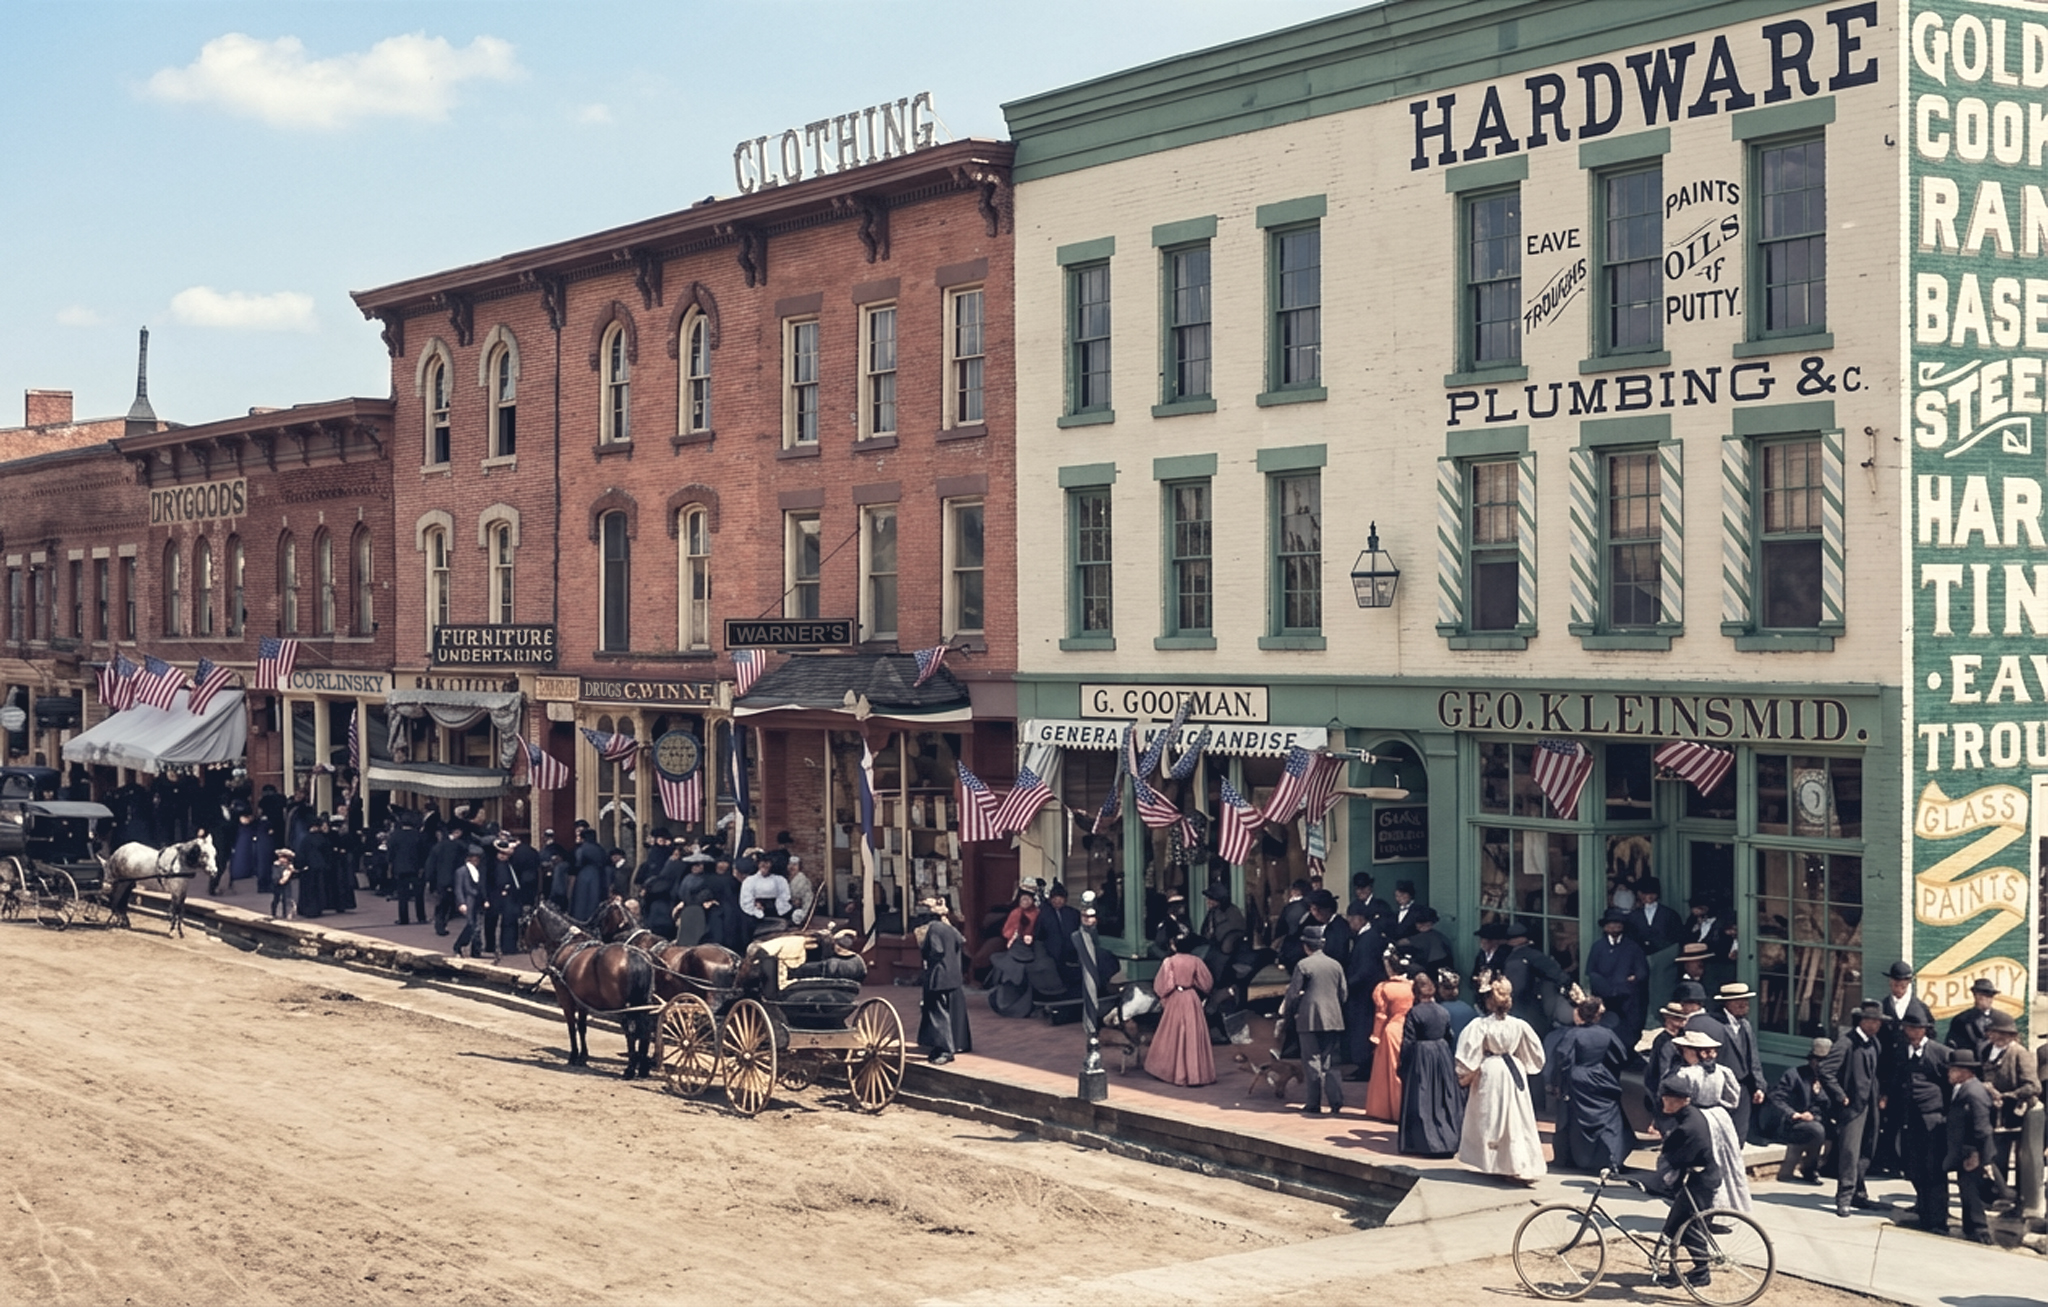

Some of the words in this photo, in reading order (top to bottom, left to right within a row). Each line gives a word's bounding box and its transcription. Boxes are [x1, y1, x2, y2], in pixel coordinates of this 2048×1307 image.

[1409, 0, 1879, 172] HARDWARE
[734, 91, 935, 195] CLOTHING
[1666, 180, 1740, 219] PAINTS
[1527, 228, 1581, 255] EAVE
[1665, 214, 1740, 280] OILS
[1666, 287, 1742, 325] PUTTY.
[1447, 362, 1775, 426] PLUMBING
[1915, 357, 2048, 449] STEE
[1918, 475, 2046, 545] HAR
[441, 628, 553, 646] FURNITURE
[736, 625, 844, 643] WARNER'S
[293, 671, 384, 693] CORLINSKY
[585, 681, 622, 698] DRUGS
[1094, 690, 1114, 713] G.
[1123, 691, 1257, 718] GOOMAN.
[1041, 725, 1132, 745] GENERA
[1923, 793, 2016, 833] GLASS
[1922, 874, 2020, 918] PAINTS
